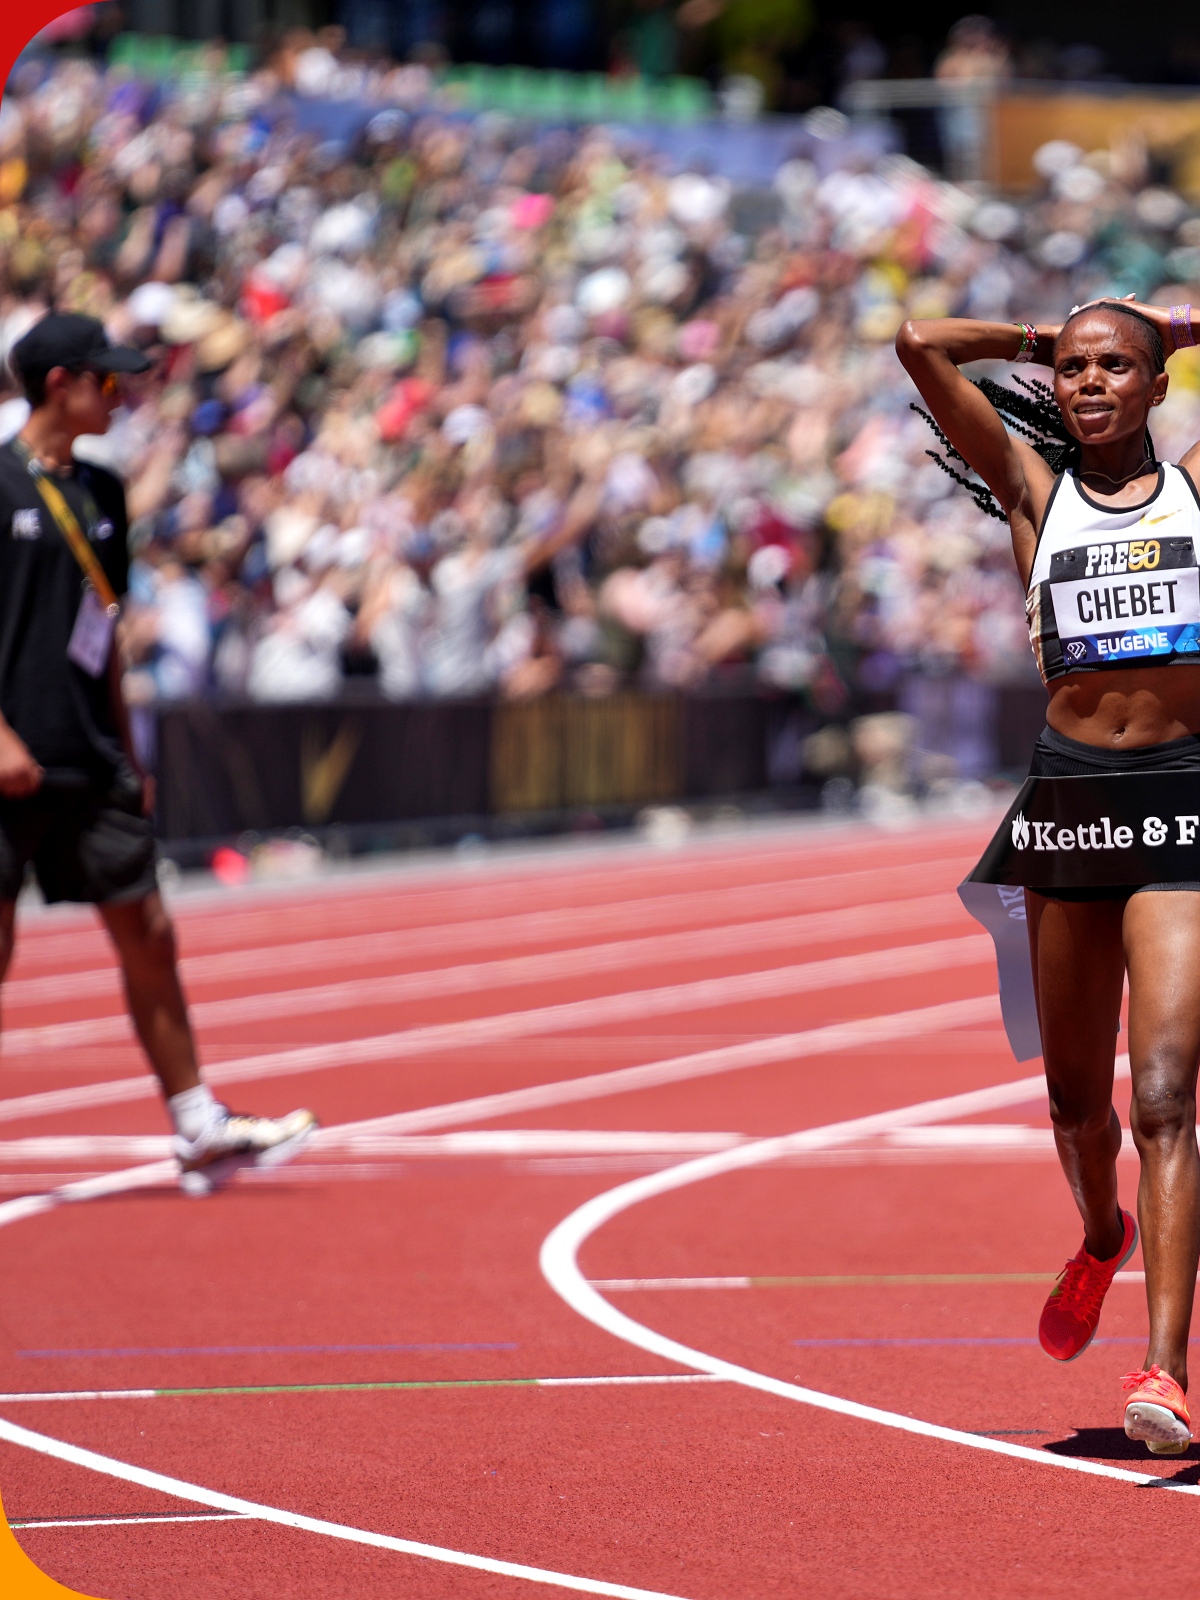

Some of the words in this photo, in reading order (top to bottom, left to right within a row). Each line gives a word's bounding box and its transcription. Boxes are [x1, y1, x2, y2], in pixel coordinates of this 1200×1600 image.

[1085, 540, 1161, 576] PRE50
[1077, 580, 1178, 623] CHEBET
[1097, 632, 1168, 655] EUGENE
[1032, 816, 1134, 851] Kettle
[1142, 816, 1168, 846] &
